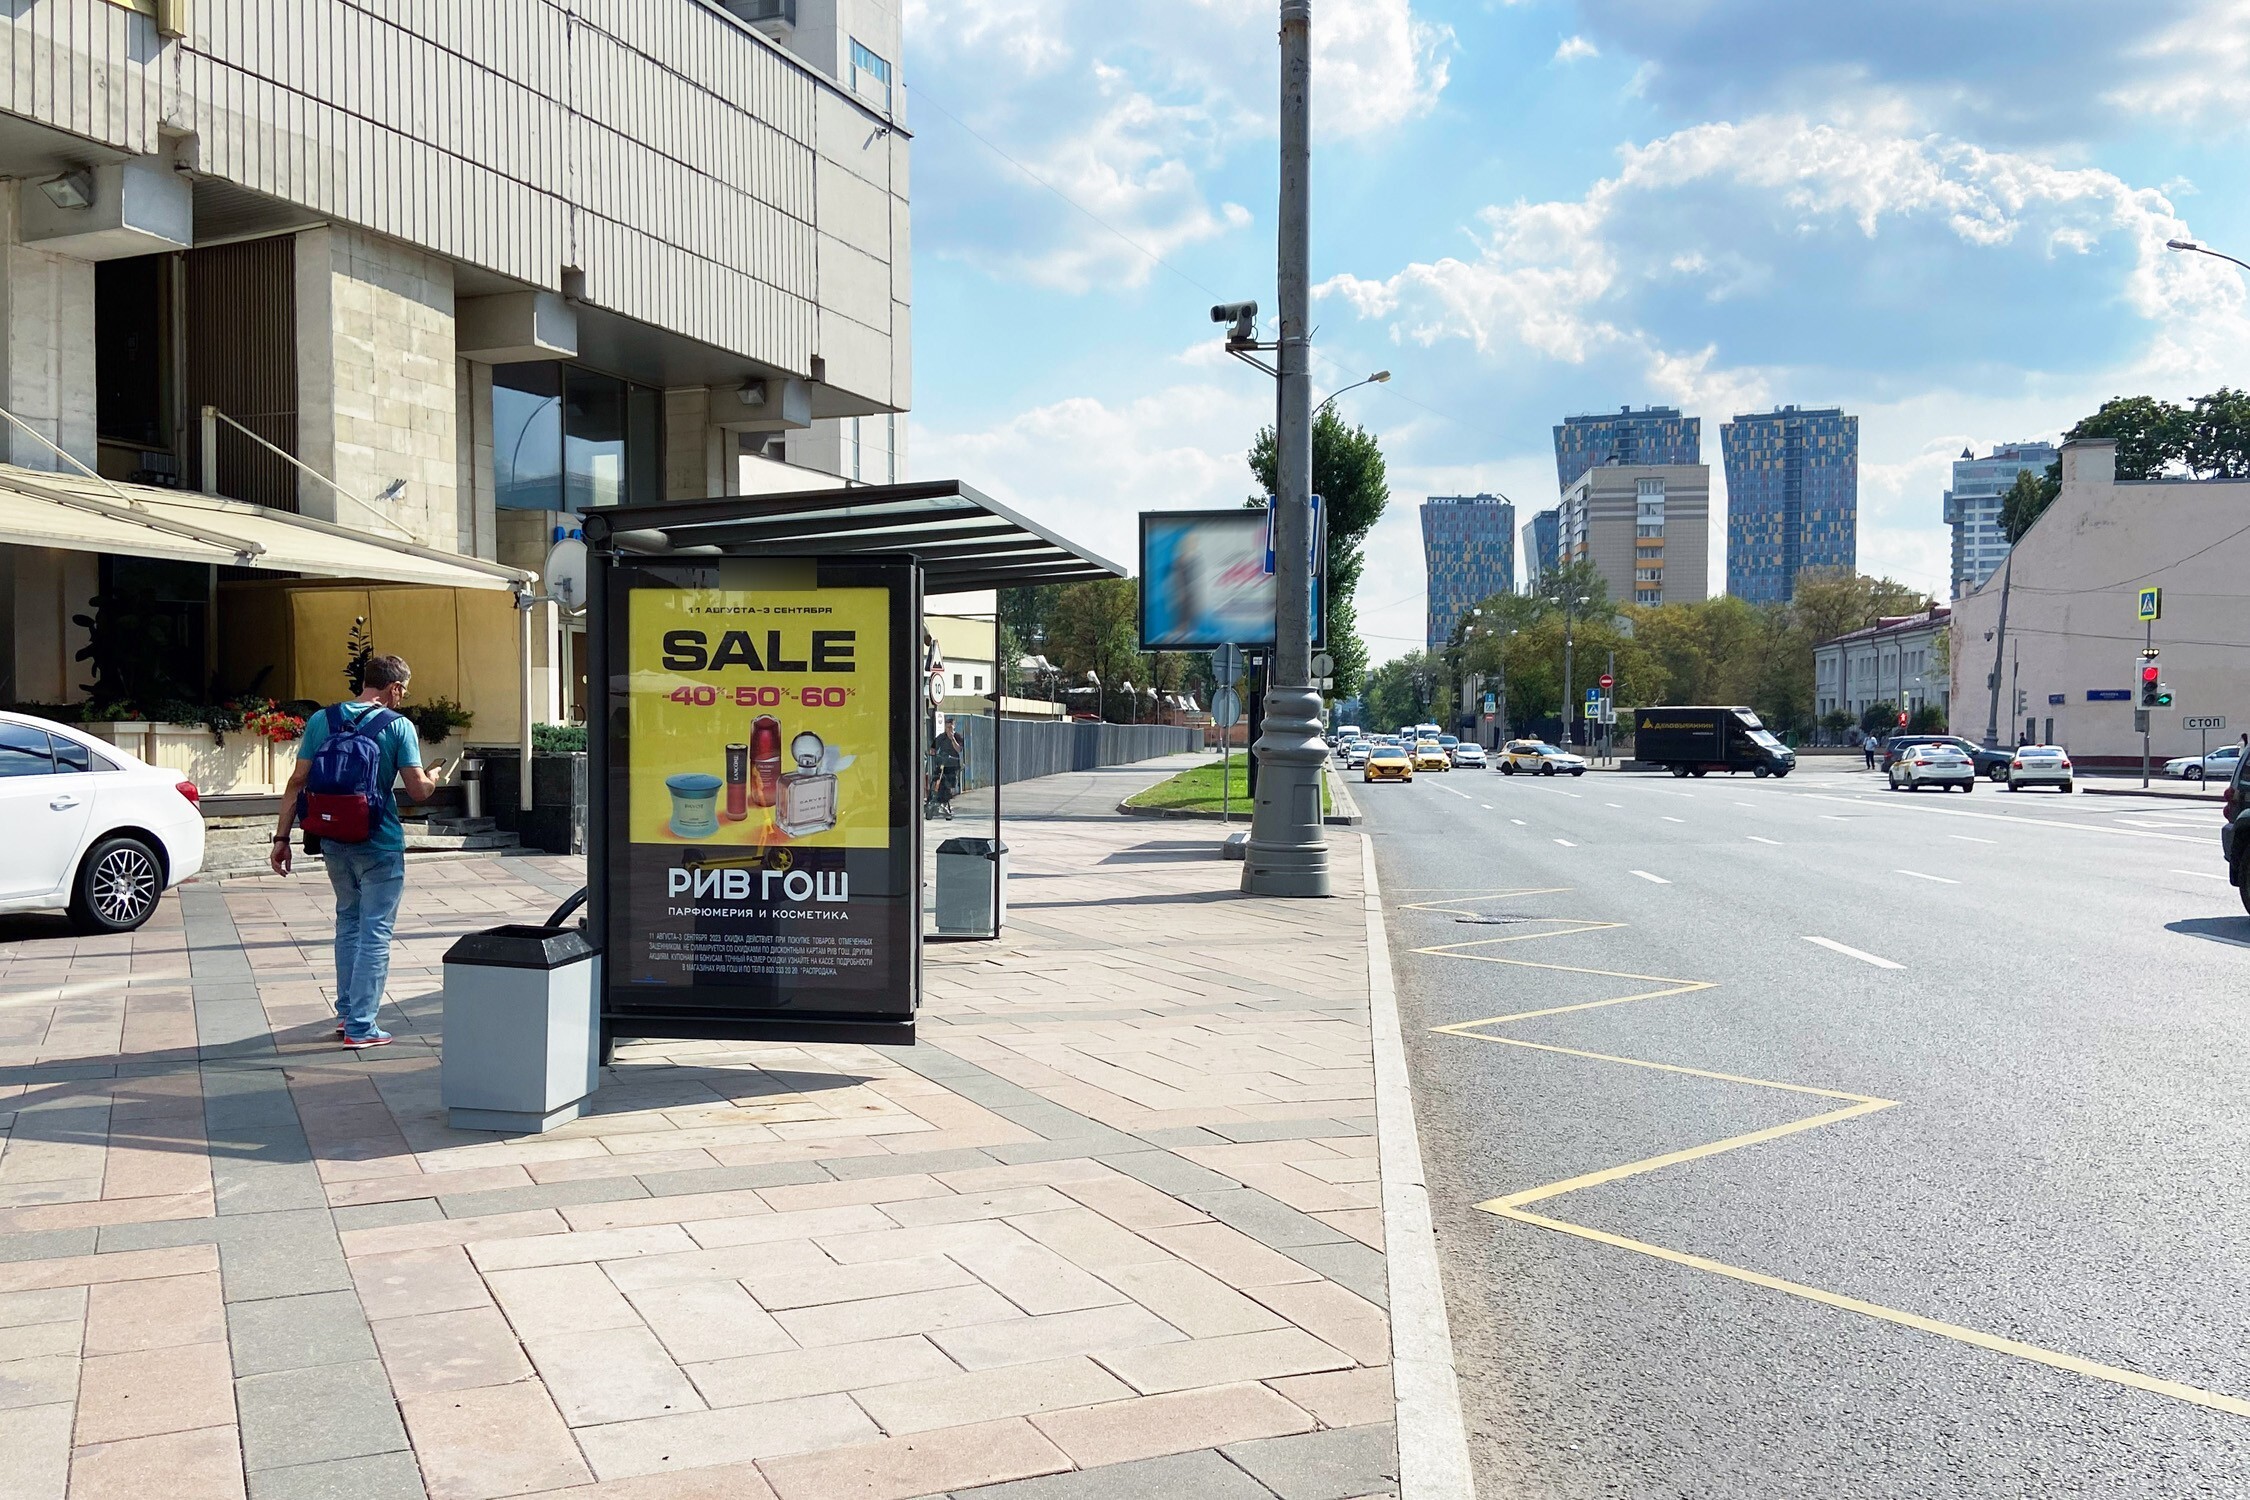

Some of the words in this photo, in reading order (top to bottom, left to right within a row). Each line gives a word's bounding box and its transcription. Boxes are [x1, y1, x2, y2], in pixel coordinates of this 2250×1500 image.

[662, 630, 856, 672] SALE
[935, 683, 942, 694] 10
[2189, 718, 2220, 728] СТОП
[668, 868, 750, 900] РИВ
[762, 870, 848, 902] ГОШ
[668, 907, 753, 918] ПАРФЮМЕРИЯ
[759, 910, 766, 918] И
[772, 910, 848, 920] КОСМЕТИКА
[788, 936, 810, 944] ПОКУПКЕ
[836, 958, 873, 966] ПОДРОБНОСТИ
